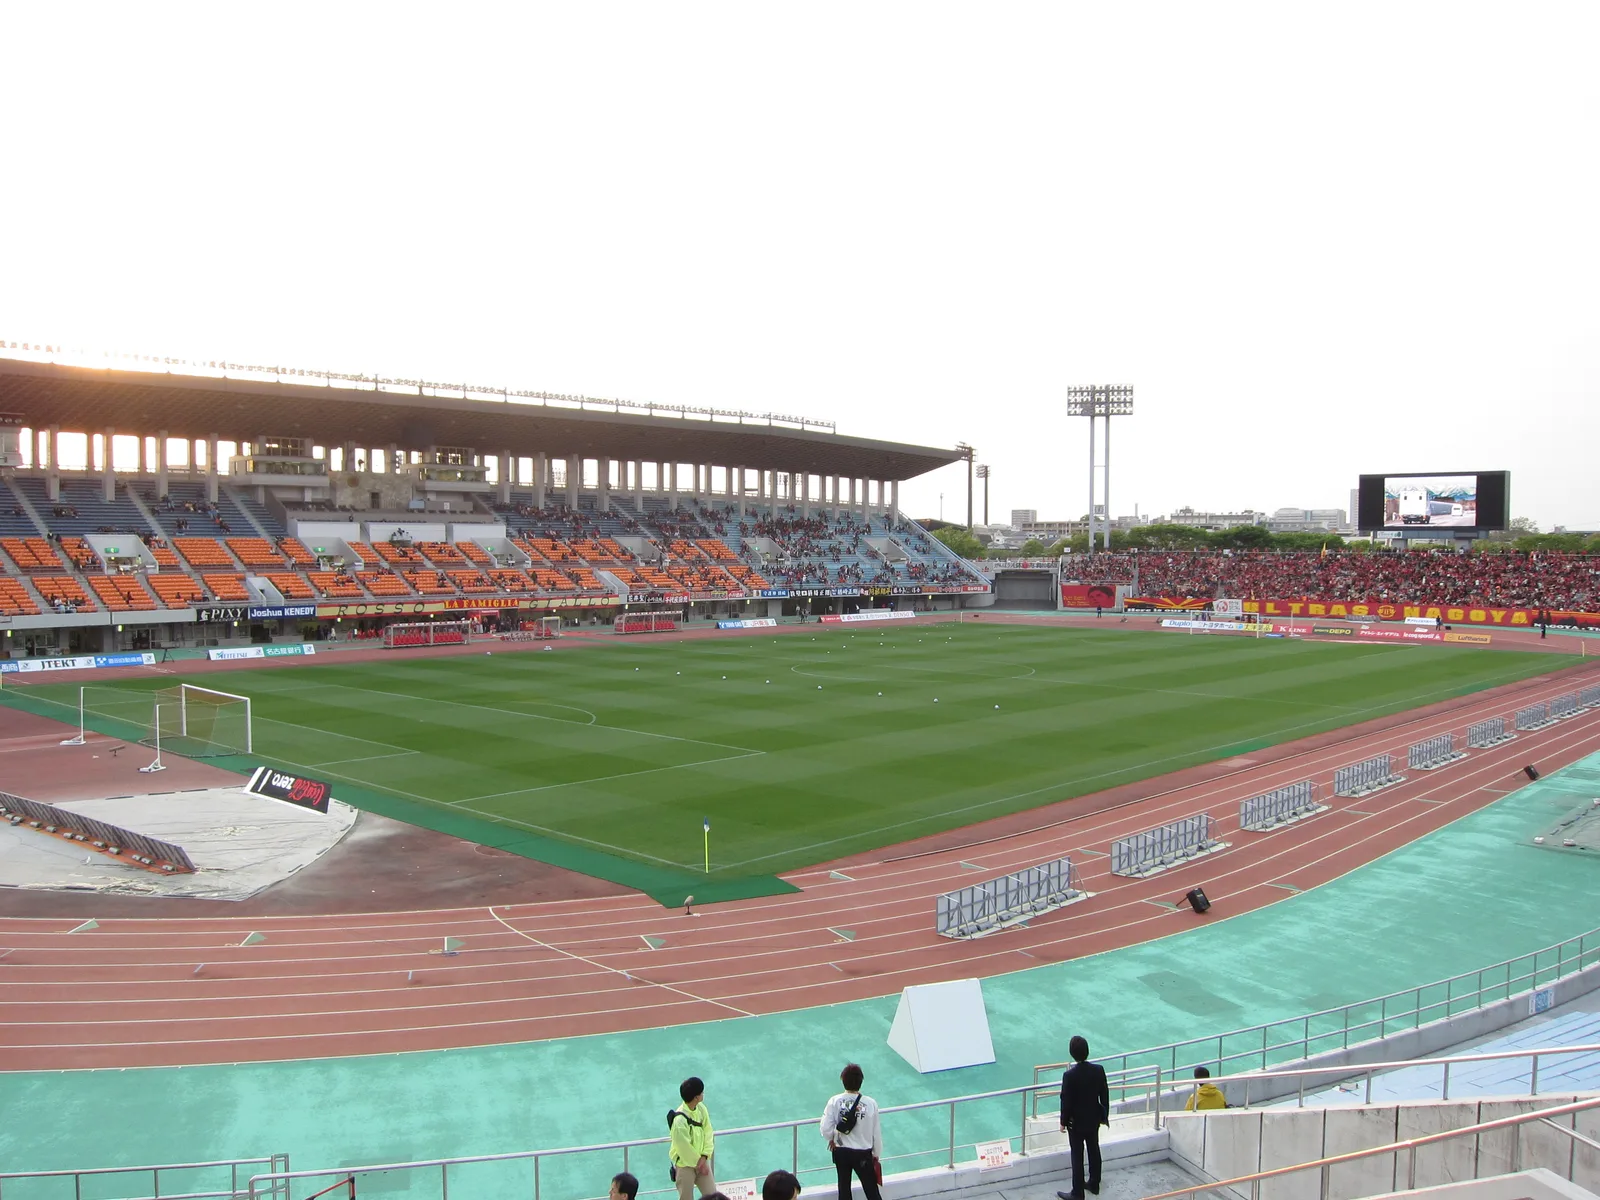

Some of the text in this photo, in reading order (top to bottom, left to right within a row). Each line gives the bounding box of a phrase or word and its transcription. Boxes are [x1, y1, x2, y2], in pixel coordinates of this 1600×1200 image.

[337, 602, 425, 616] ROSSO
[445, 599, 519, 609] LA FAMIGLIA
[529, 597, 610, 610] GIALLO
[211, 608, 245, 619] PIXY
[251, 606, 315, 618] Joshua KENEDY
[1243, 602, 1369, 616] ULTRAS
[1404, 606, 1528, 624] NAGOYA
[40, 659, 77, 670] JTEKT
[839, 1110, 866, 1120] SFF
